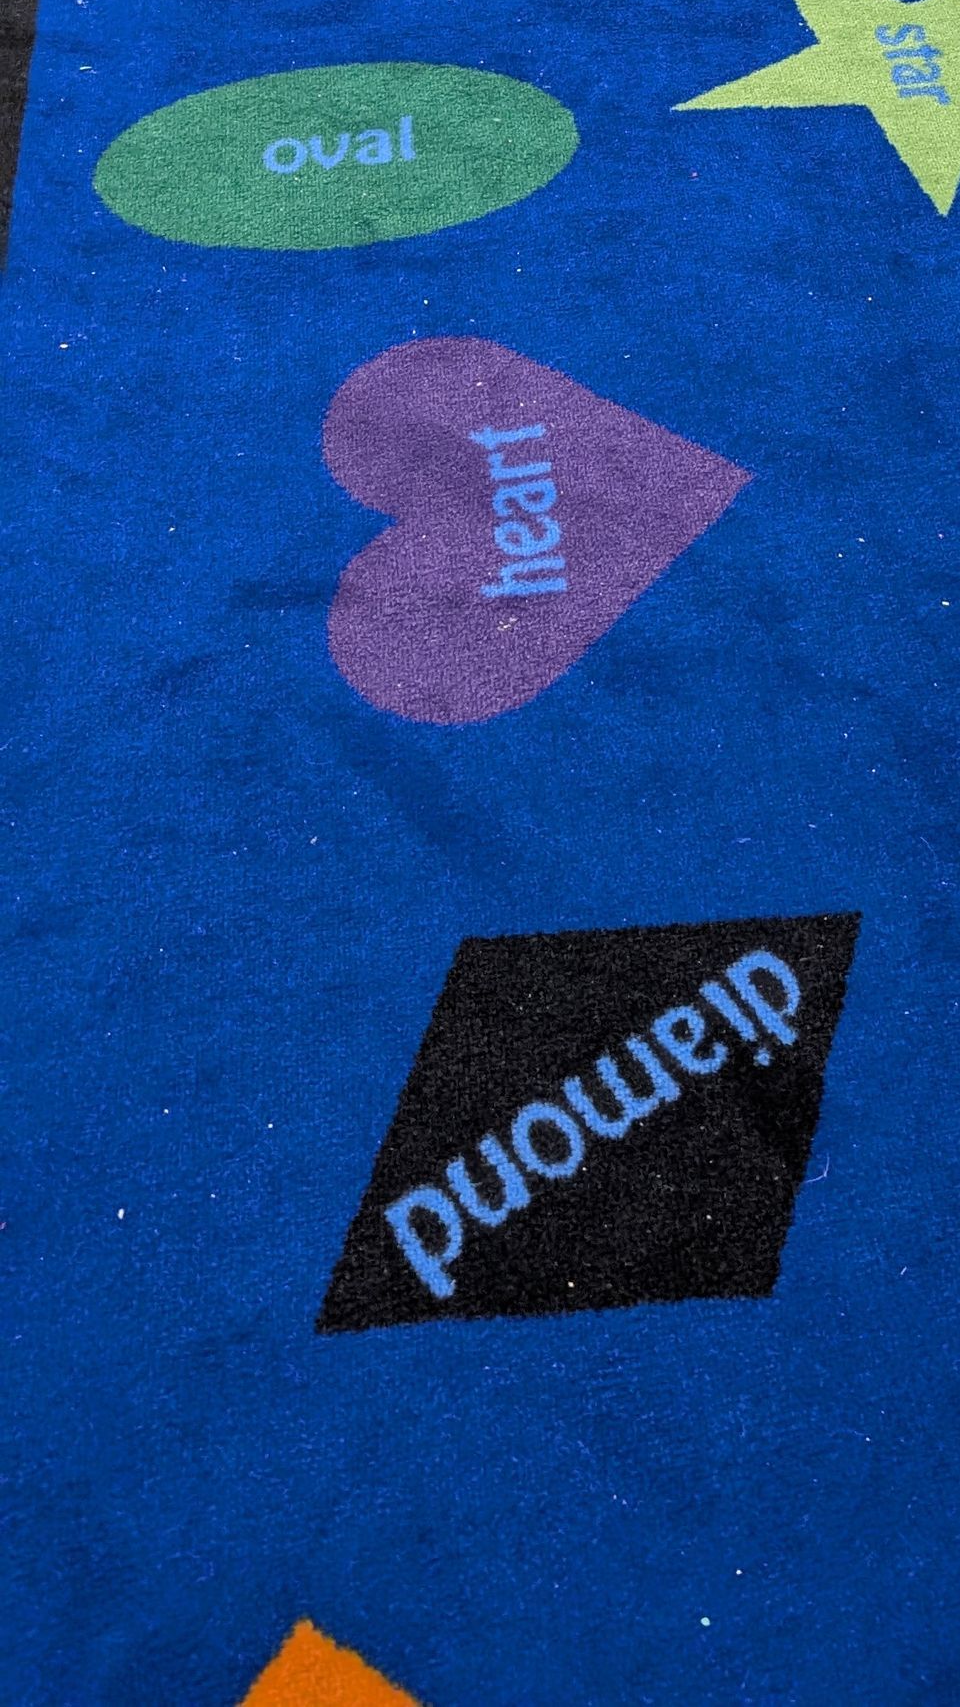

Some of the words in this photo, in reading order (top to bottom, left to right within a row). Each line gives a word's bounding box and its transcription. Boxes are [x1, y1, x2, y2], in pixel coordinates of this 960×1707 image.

[876, 23, 951, 106] star
[262, 115, 416, 175] oval
[467, 421, 569, 599] heart
[384, 949, 801, 1298] diamond
